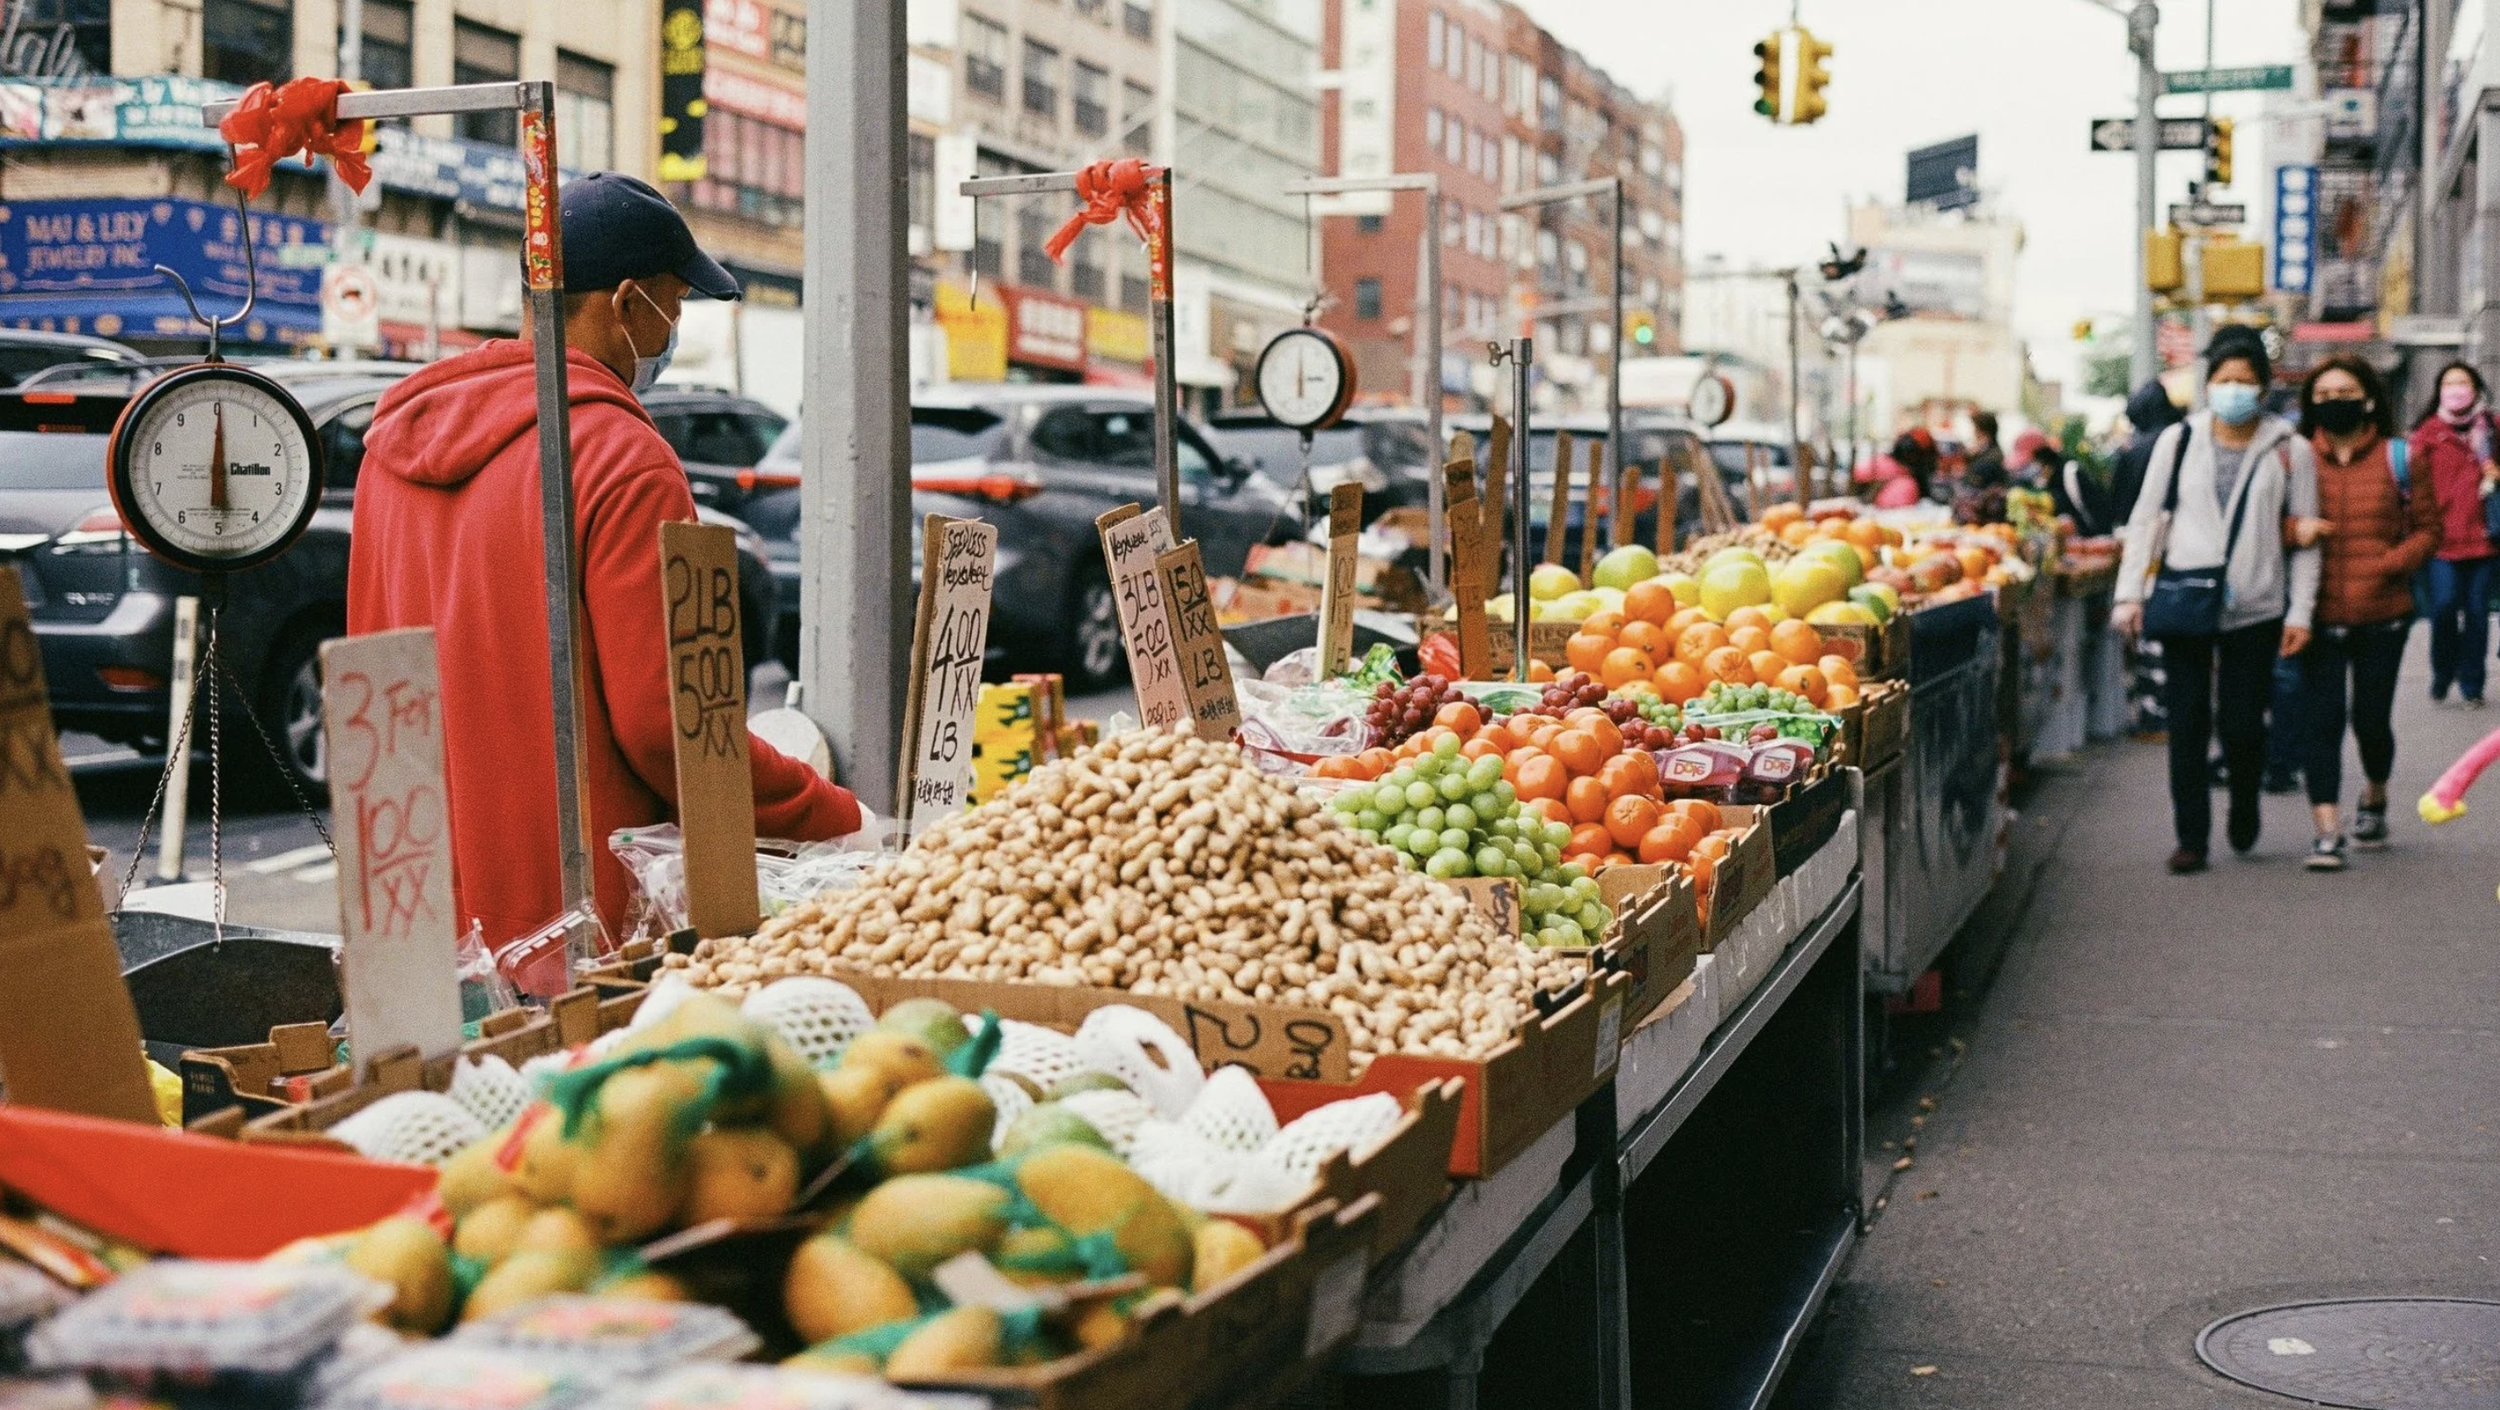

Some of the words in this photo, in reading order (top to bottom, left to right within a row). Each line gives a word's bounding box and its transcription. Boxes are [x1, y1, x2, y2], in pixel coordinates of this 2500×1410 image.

[176, 414, 185, 426] 9
[253, 415, 257, 427] 1
[154, 443, 162, 455] 8
[274, 443, 281, 456] 2
[230, 462, 271, 476] Chatillon
[154, 482, 162, 495] 7
[275, 482, 282, 495] 3
[178, 511, 186, 523] 6
[251, 511, 259, 523] 4
[214, 522, 222, 535] 5
[1193, 650, 1223, 688] LB
[929, 720, 959, 762] LB
[1674, 759, 1706, 777] Dole
[1764, 757, 1790, 773] Dole
